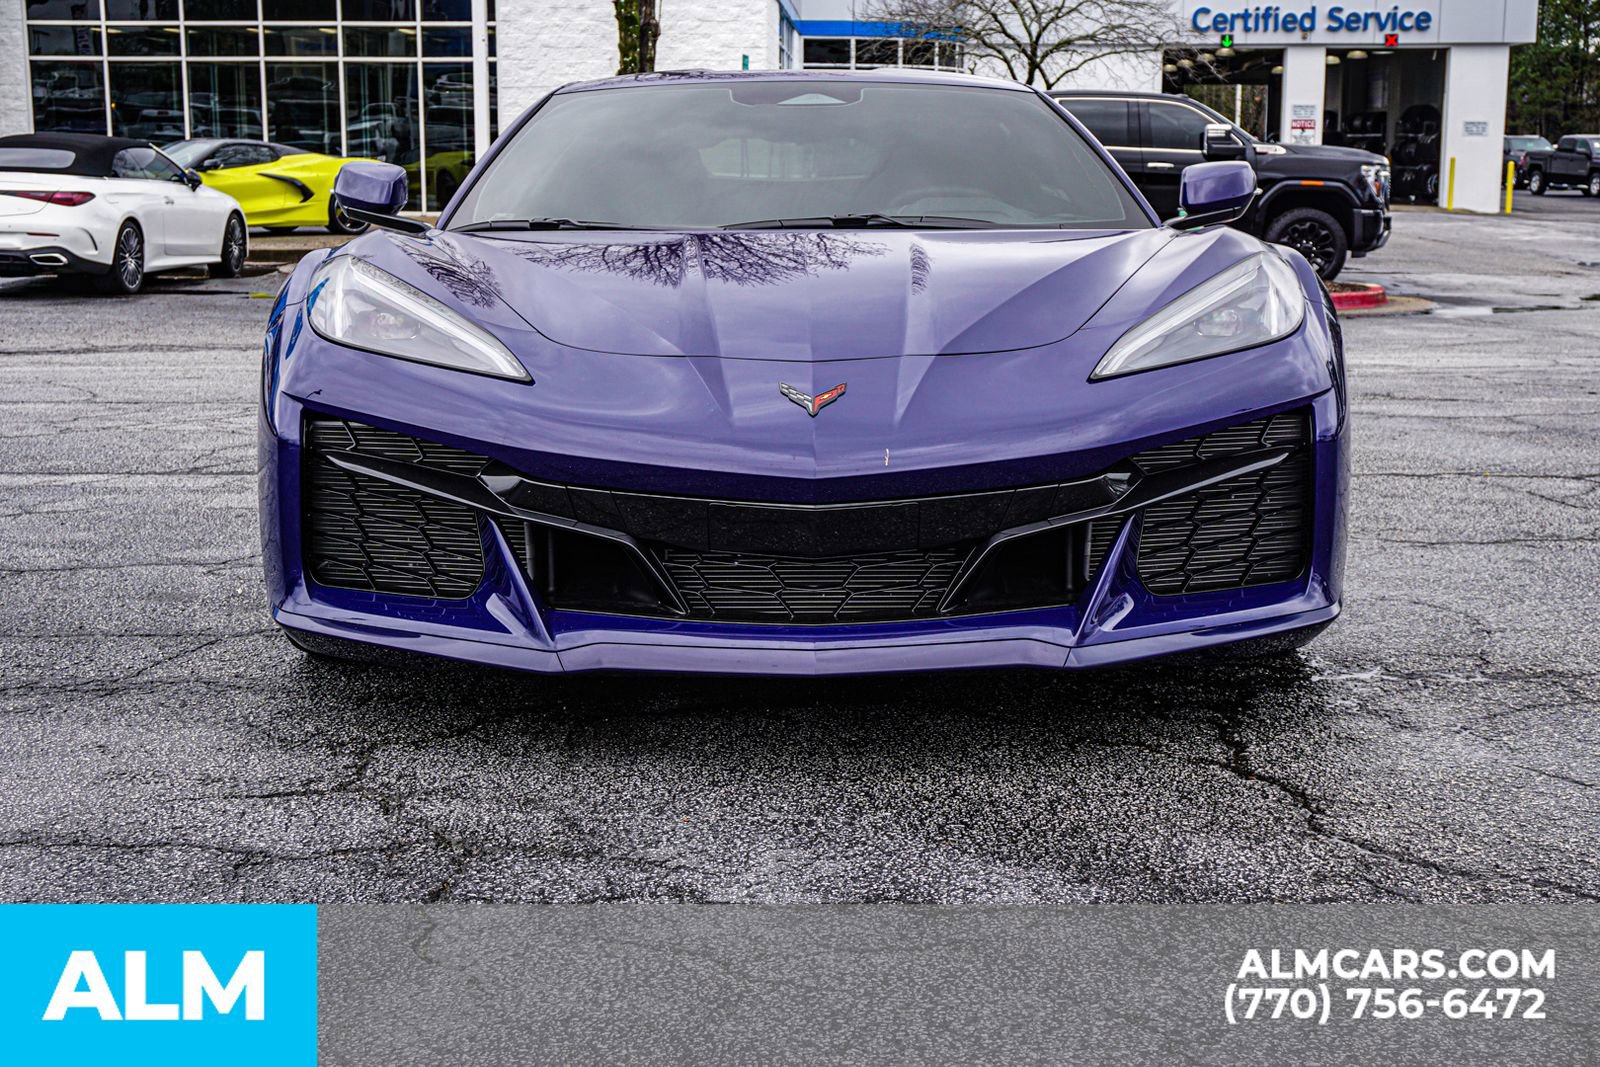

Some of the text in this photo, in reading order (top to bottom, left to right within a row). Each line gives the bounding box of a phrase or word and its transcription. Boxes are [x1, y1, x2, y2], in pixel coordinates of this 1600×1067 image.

[1192, 6, 1432, 33] Certified Service
[1292, 120, 1315, 128] NOTICE
